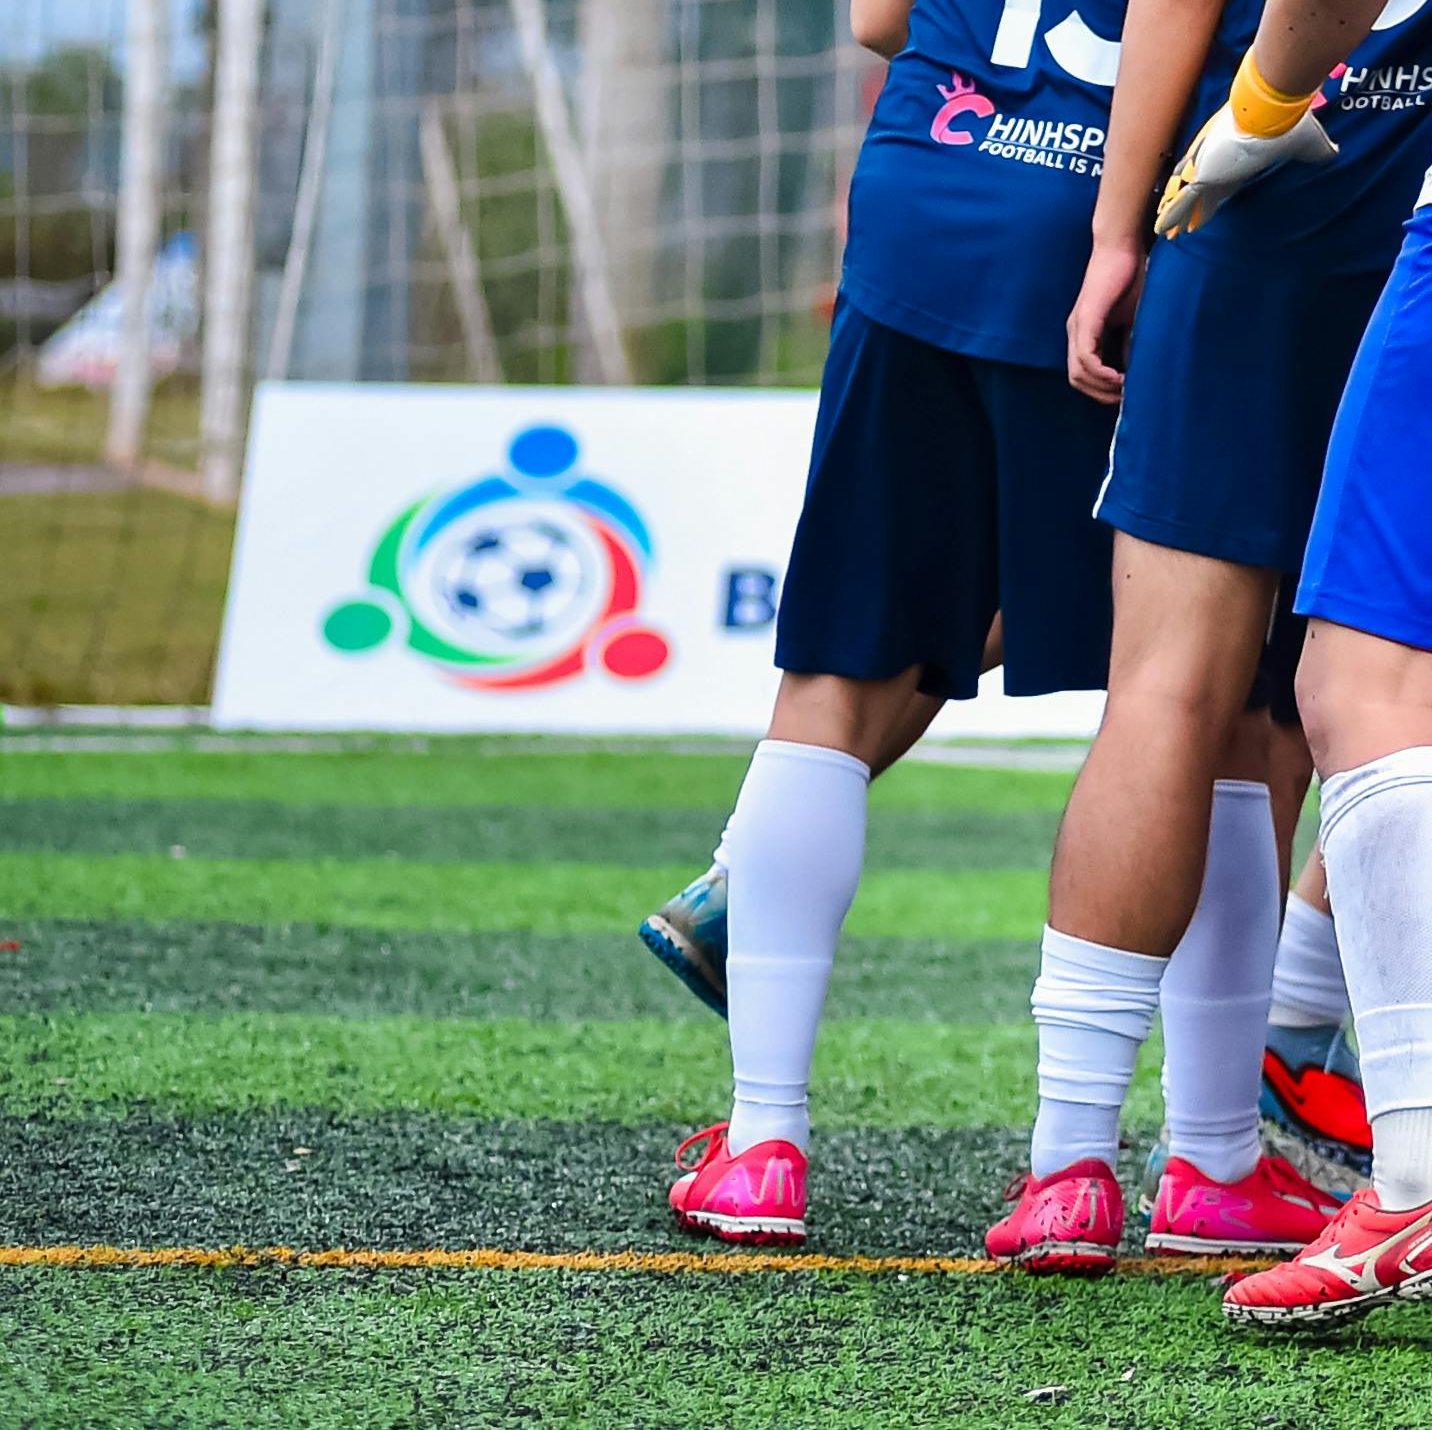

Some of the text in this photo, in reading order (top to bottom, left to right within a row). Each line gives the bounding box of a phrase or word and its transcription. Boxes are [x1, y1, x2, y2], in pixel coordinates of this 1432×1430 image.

[930, 93, 1109, 154] CHINHSP
[978, 141, 1064, 170] FOOTBALL
[1069, 156, 1088, 175] IS
[720, 568, 777, 630] B
